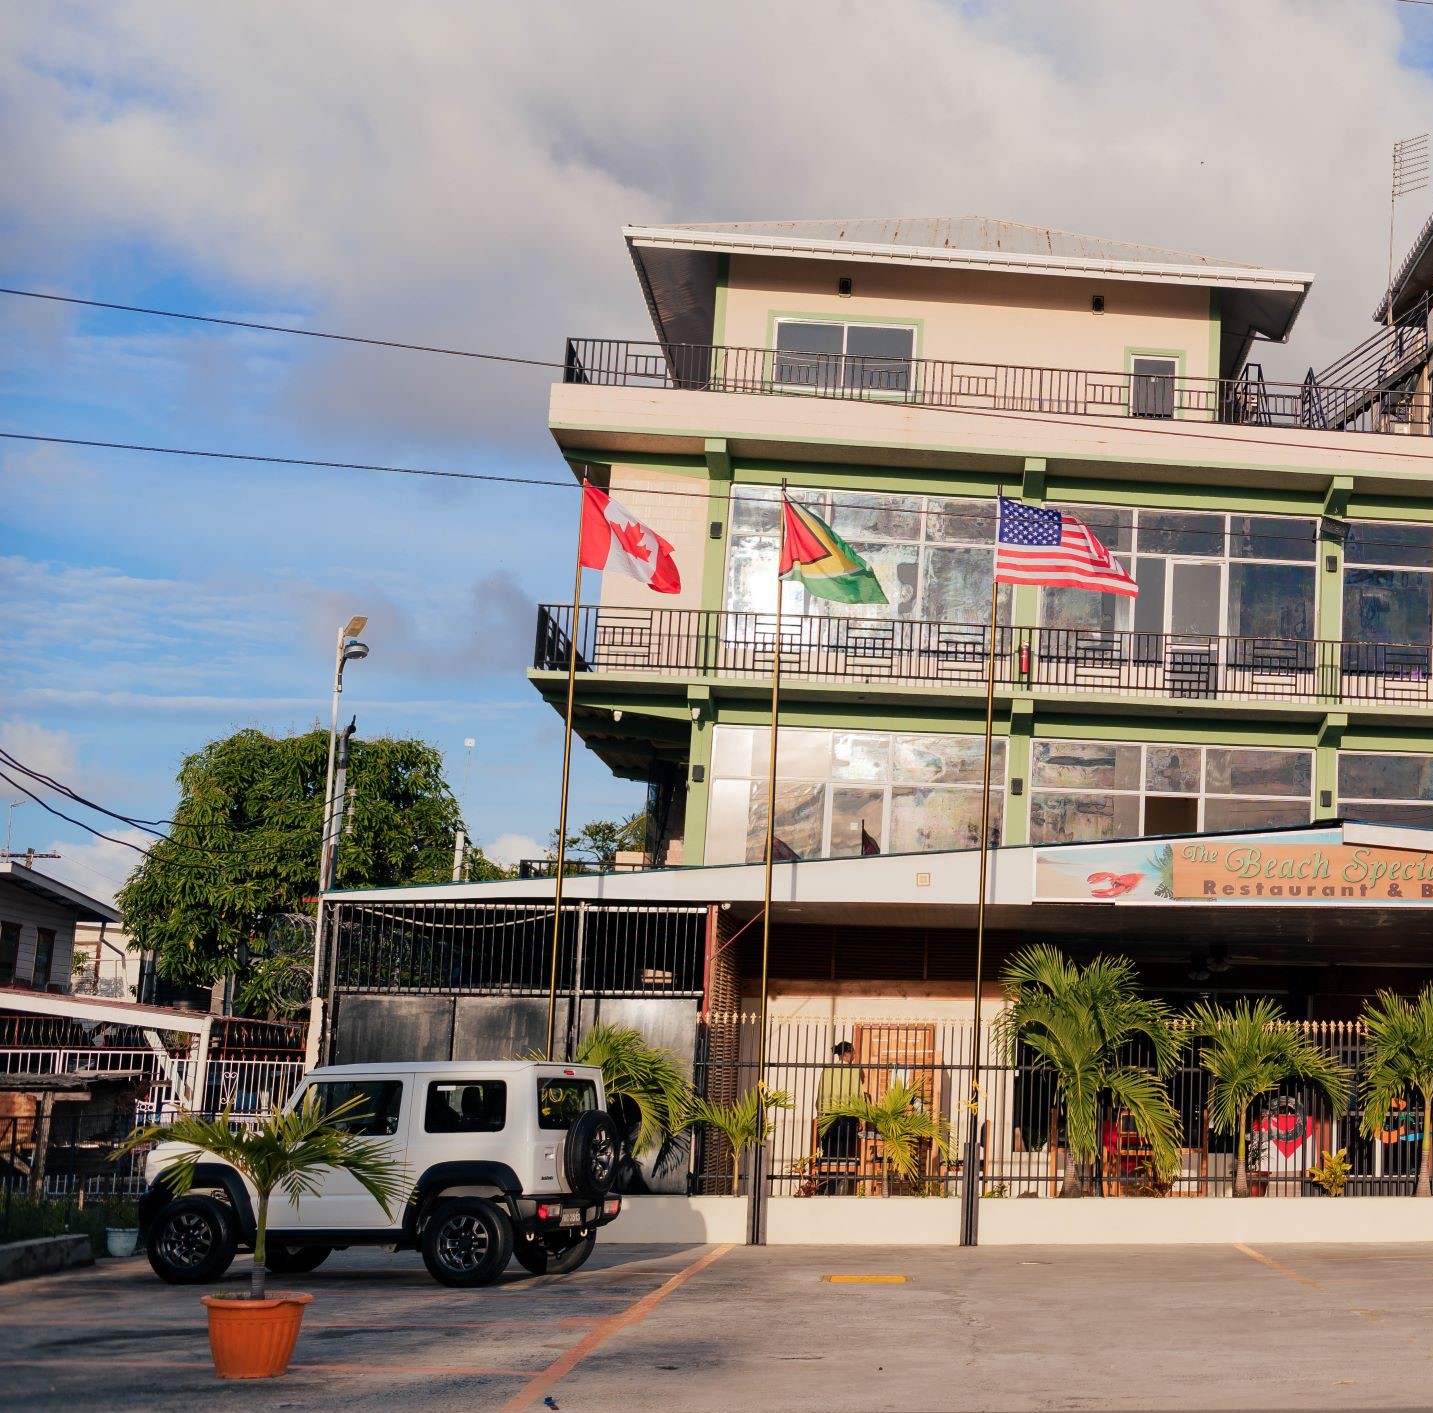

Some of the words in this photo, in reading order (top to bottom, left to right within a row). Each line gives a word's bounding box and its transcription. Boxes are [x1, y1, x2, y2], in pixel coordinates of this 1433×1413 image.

[1181, 843, 1219, 864] The
[1224, 846, 1331, 879] Beach
[1203, 879, 1368, 897] Restaurant
[1387, 882, 1403, 898] &
